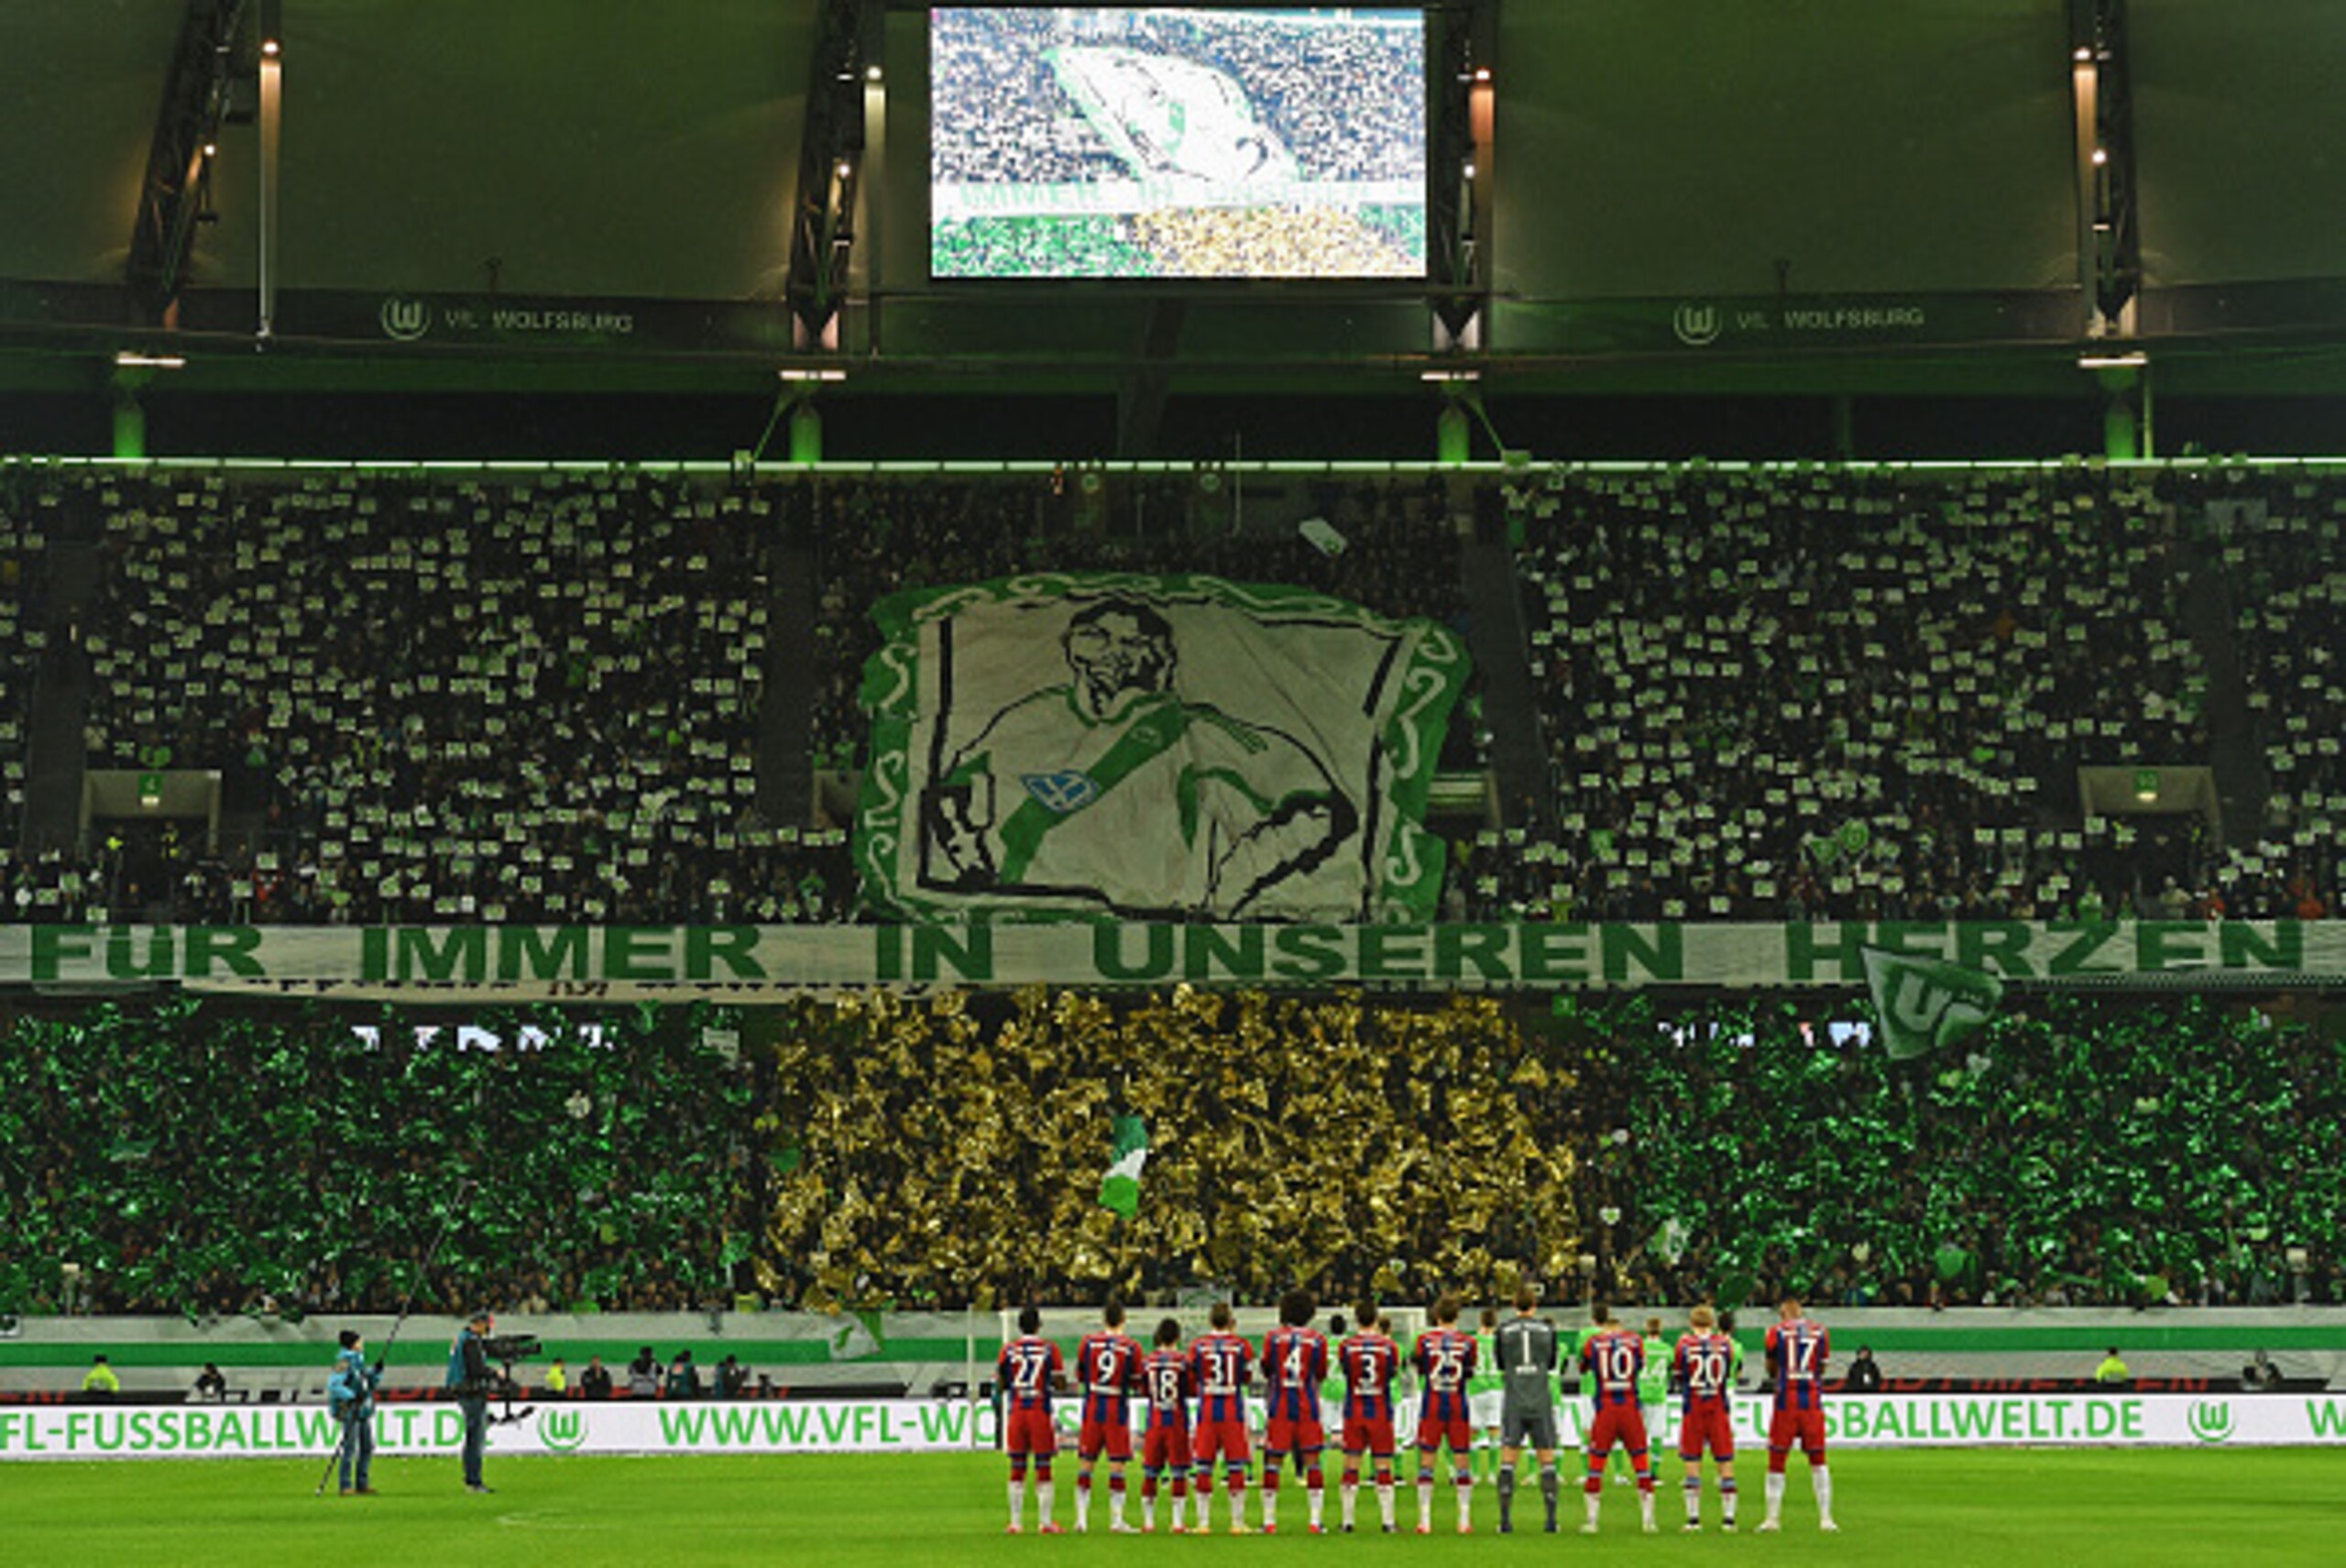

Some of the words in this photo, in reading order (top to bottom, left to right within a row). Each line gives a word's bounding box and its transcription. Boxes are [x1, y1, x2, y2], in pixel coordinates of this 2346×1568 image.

[492, 310, 634, 334] WOLFSBURG
[1784, 306, 1924, 328] WOLFSBURG
[362, 925, 768, 980] IMMER
[876, 924, 993, 980] IN
[1094, 923, 1683, 980] UNSEREN
[1788, 919, 2303, 980] HERZEN
[1283, 1345, 1302, 1379] 4
[1522, 1330, 1531, 1365] 1
[1598, 1345, 1635, 1380] 10
[1787, 1336, 1818, 1373] 17
[1010, 1354, 1046, 1387] 27
[1097, 1350, 1117, 1384] 9
[1203, 1353, 1234, 1385] 31
[1357, 1353, 1377, 1385] 3
[1428, 1350, 1464, 1384] 25
[1689, 1353, 1727, 1388] 20
[1148, 1368, 1178, 1407] 18
